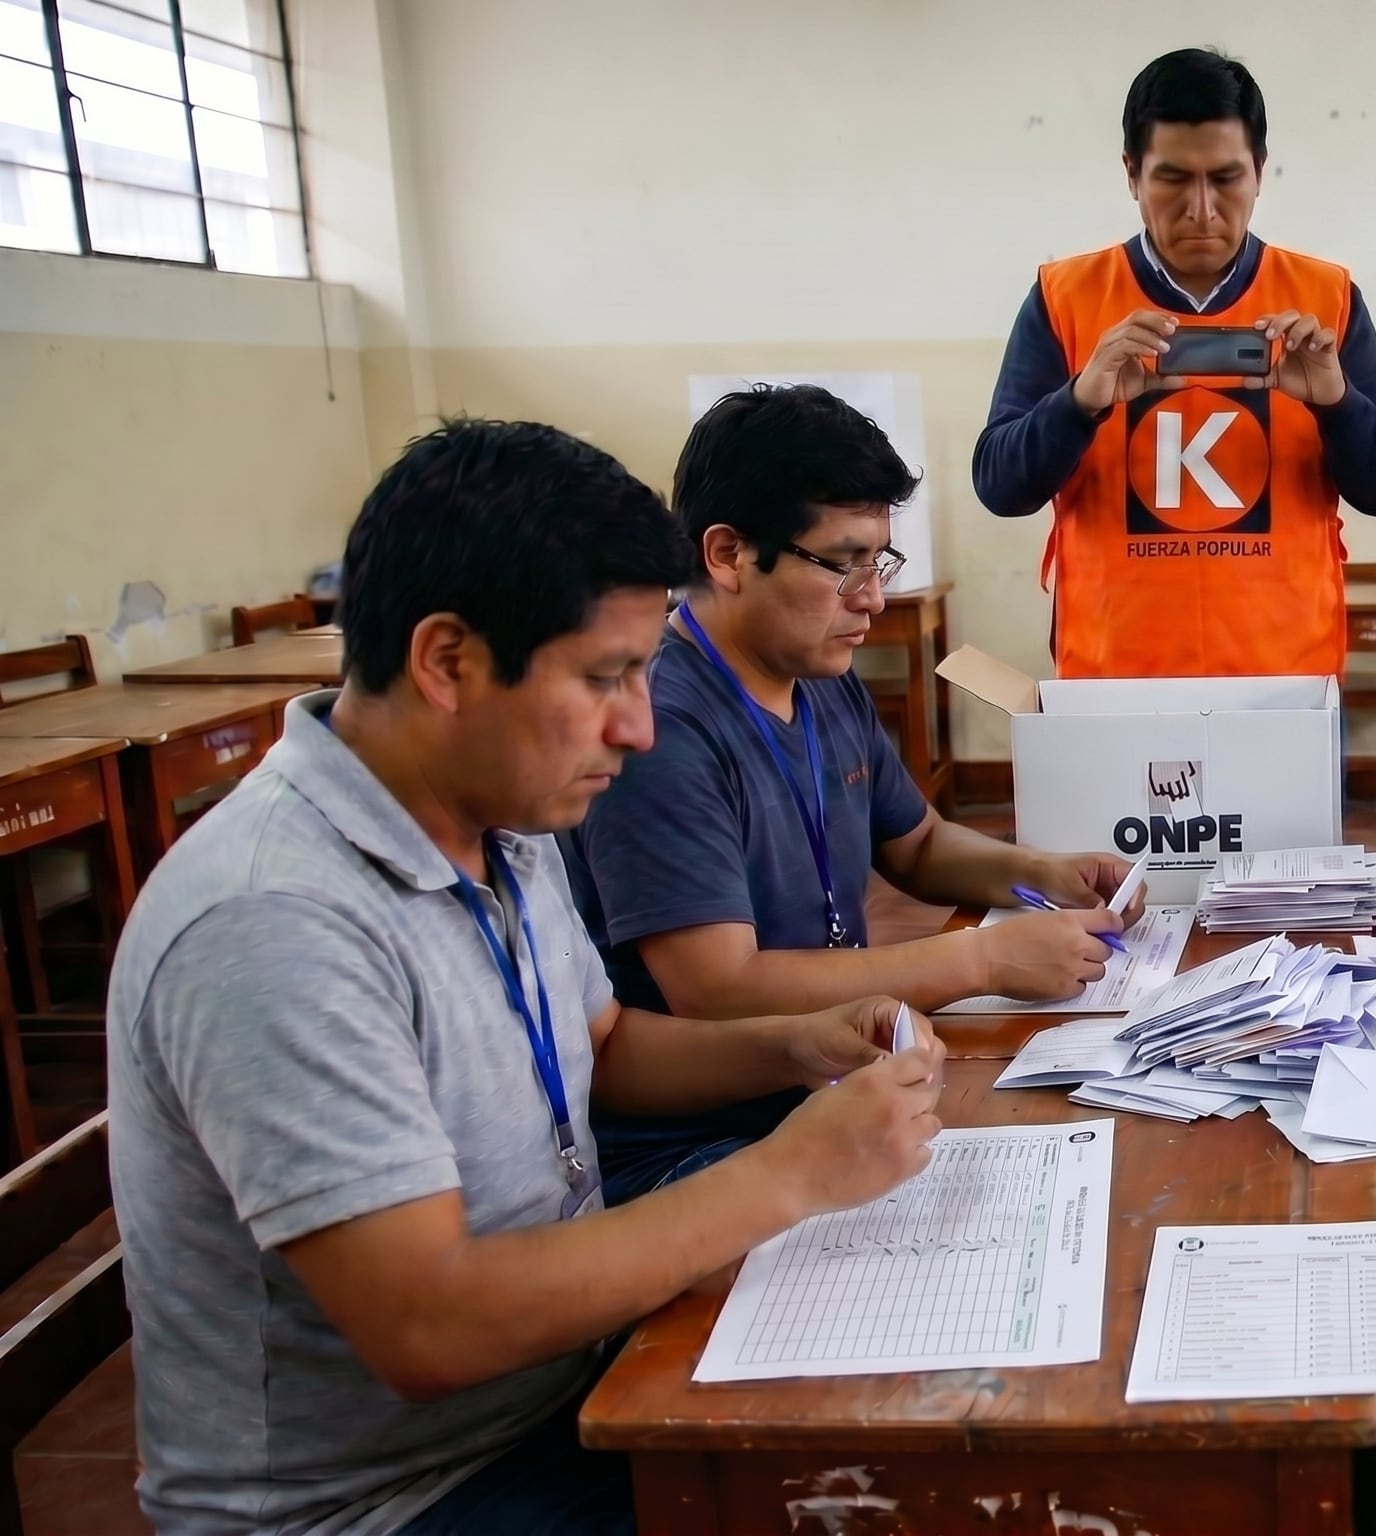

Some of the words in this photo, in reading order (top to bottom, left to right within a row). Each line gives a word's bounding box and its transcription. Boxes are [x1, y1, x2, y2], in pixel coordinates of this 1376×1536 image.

[1155, 411, 1246, 509] K
[1127, 541, 1191, 558] FUERZA
[1197, 541, 1272, 557] POPULAR
[1113, 814, 1243, 855] ONPE
